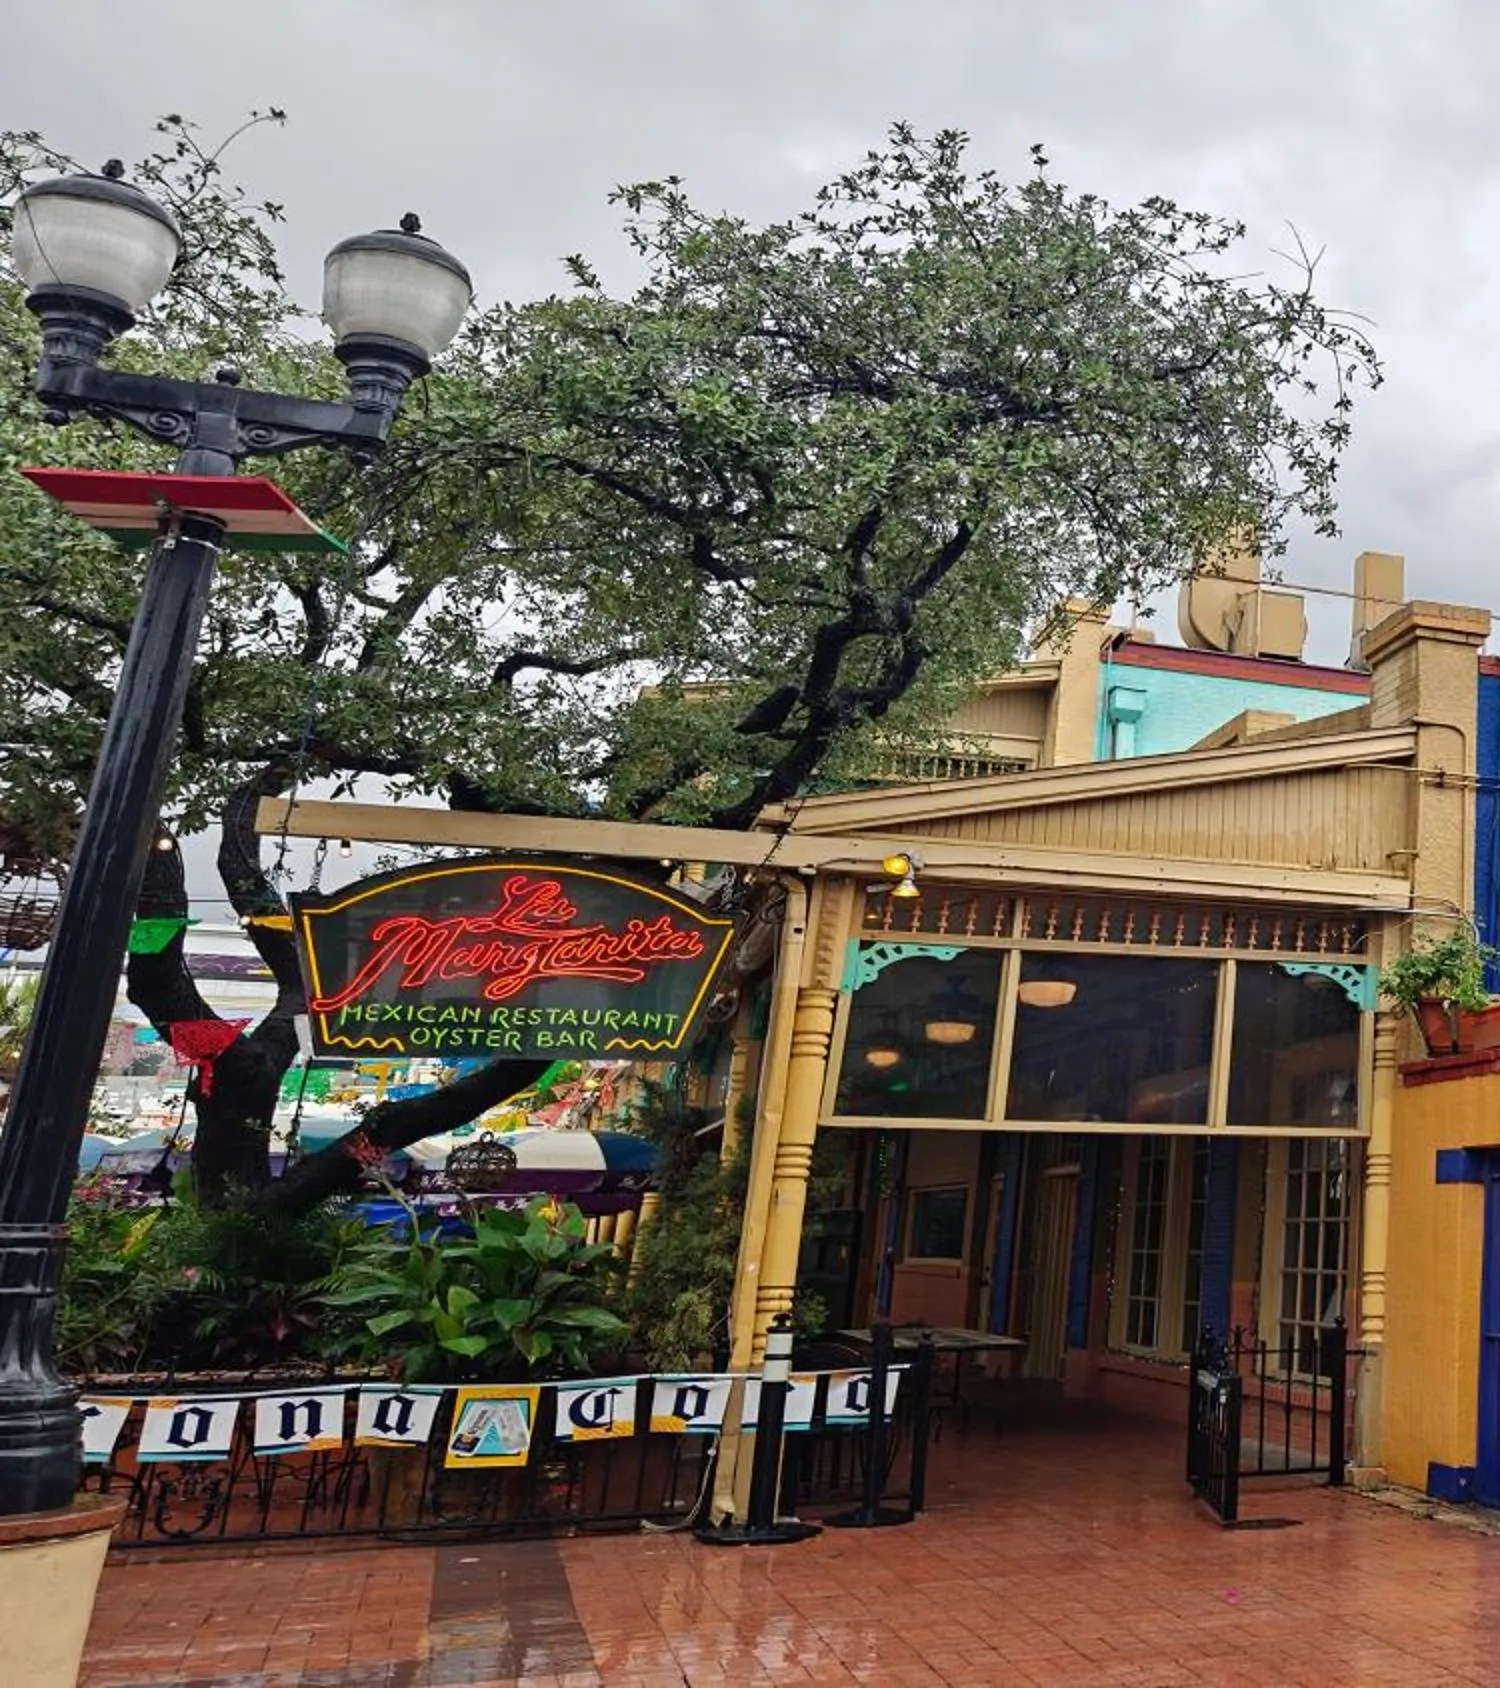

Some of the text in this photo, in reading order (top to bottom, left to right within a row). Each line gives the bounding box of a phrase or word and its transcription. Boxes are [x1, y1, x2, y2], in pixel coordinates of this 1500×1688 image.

[311, 916, 705, 1010] Margarita
[339, 1004, 680, 1035] MEXICAN RESTAURANT
[409, 1028, 598, 1051] OYSTER BAR
